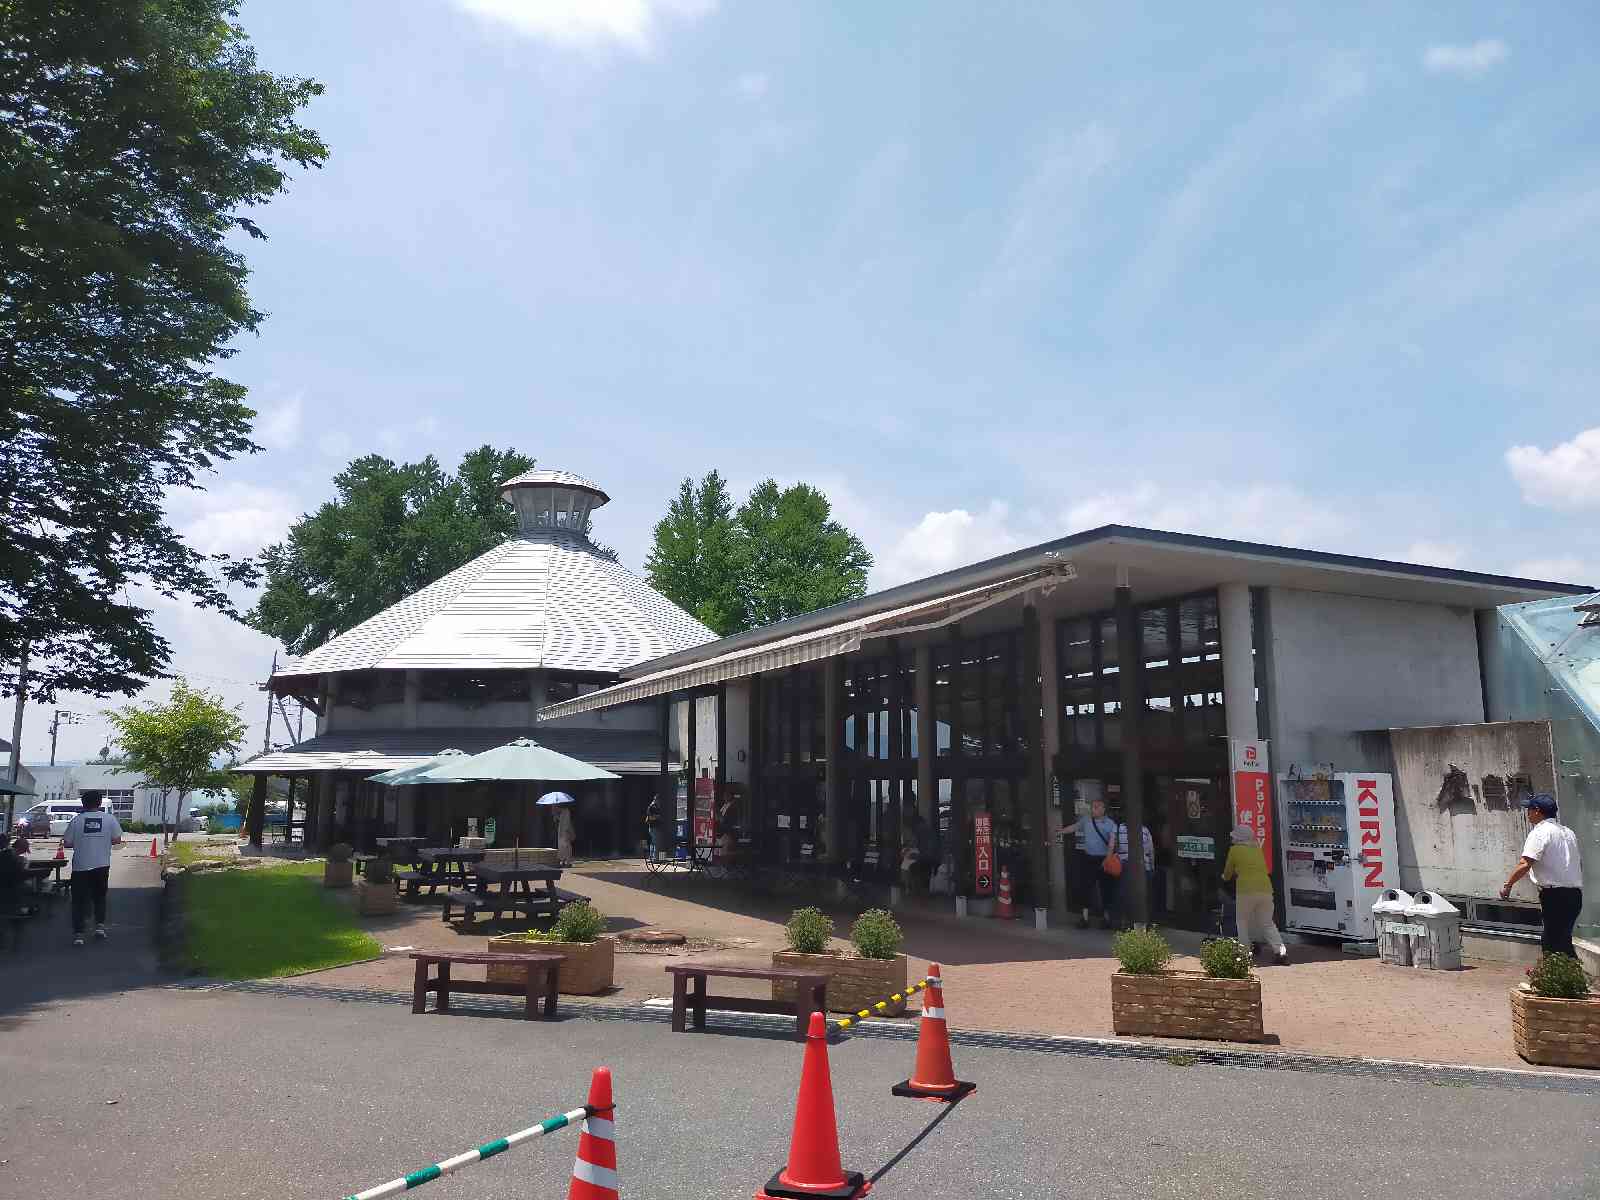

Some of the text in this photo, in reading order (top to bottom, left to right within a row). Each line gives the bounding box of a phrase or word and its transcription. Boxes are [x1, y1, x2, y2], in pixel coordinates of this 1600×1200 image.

[1255, 779, 1266, 849] PayPay
[1357, 780, 1384, 888] KIRIN
[978, 846, 989, 871] 入口
